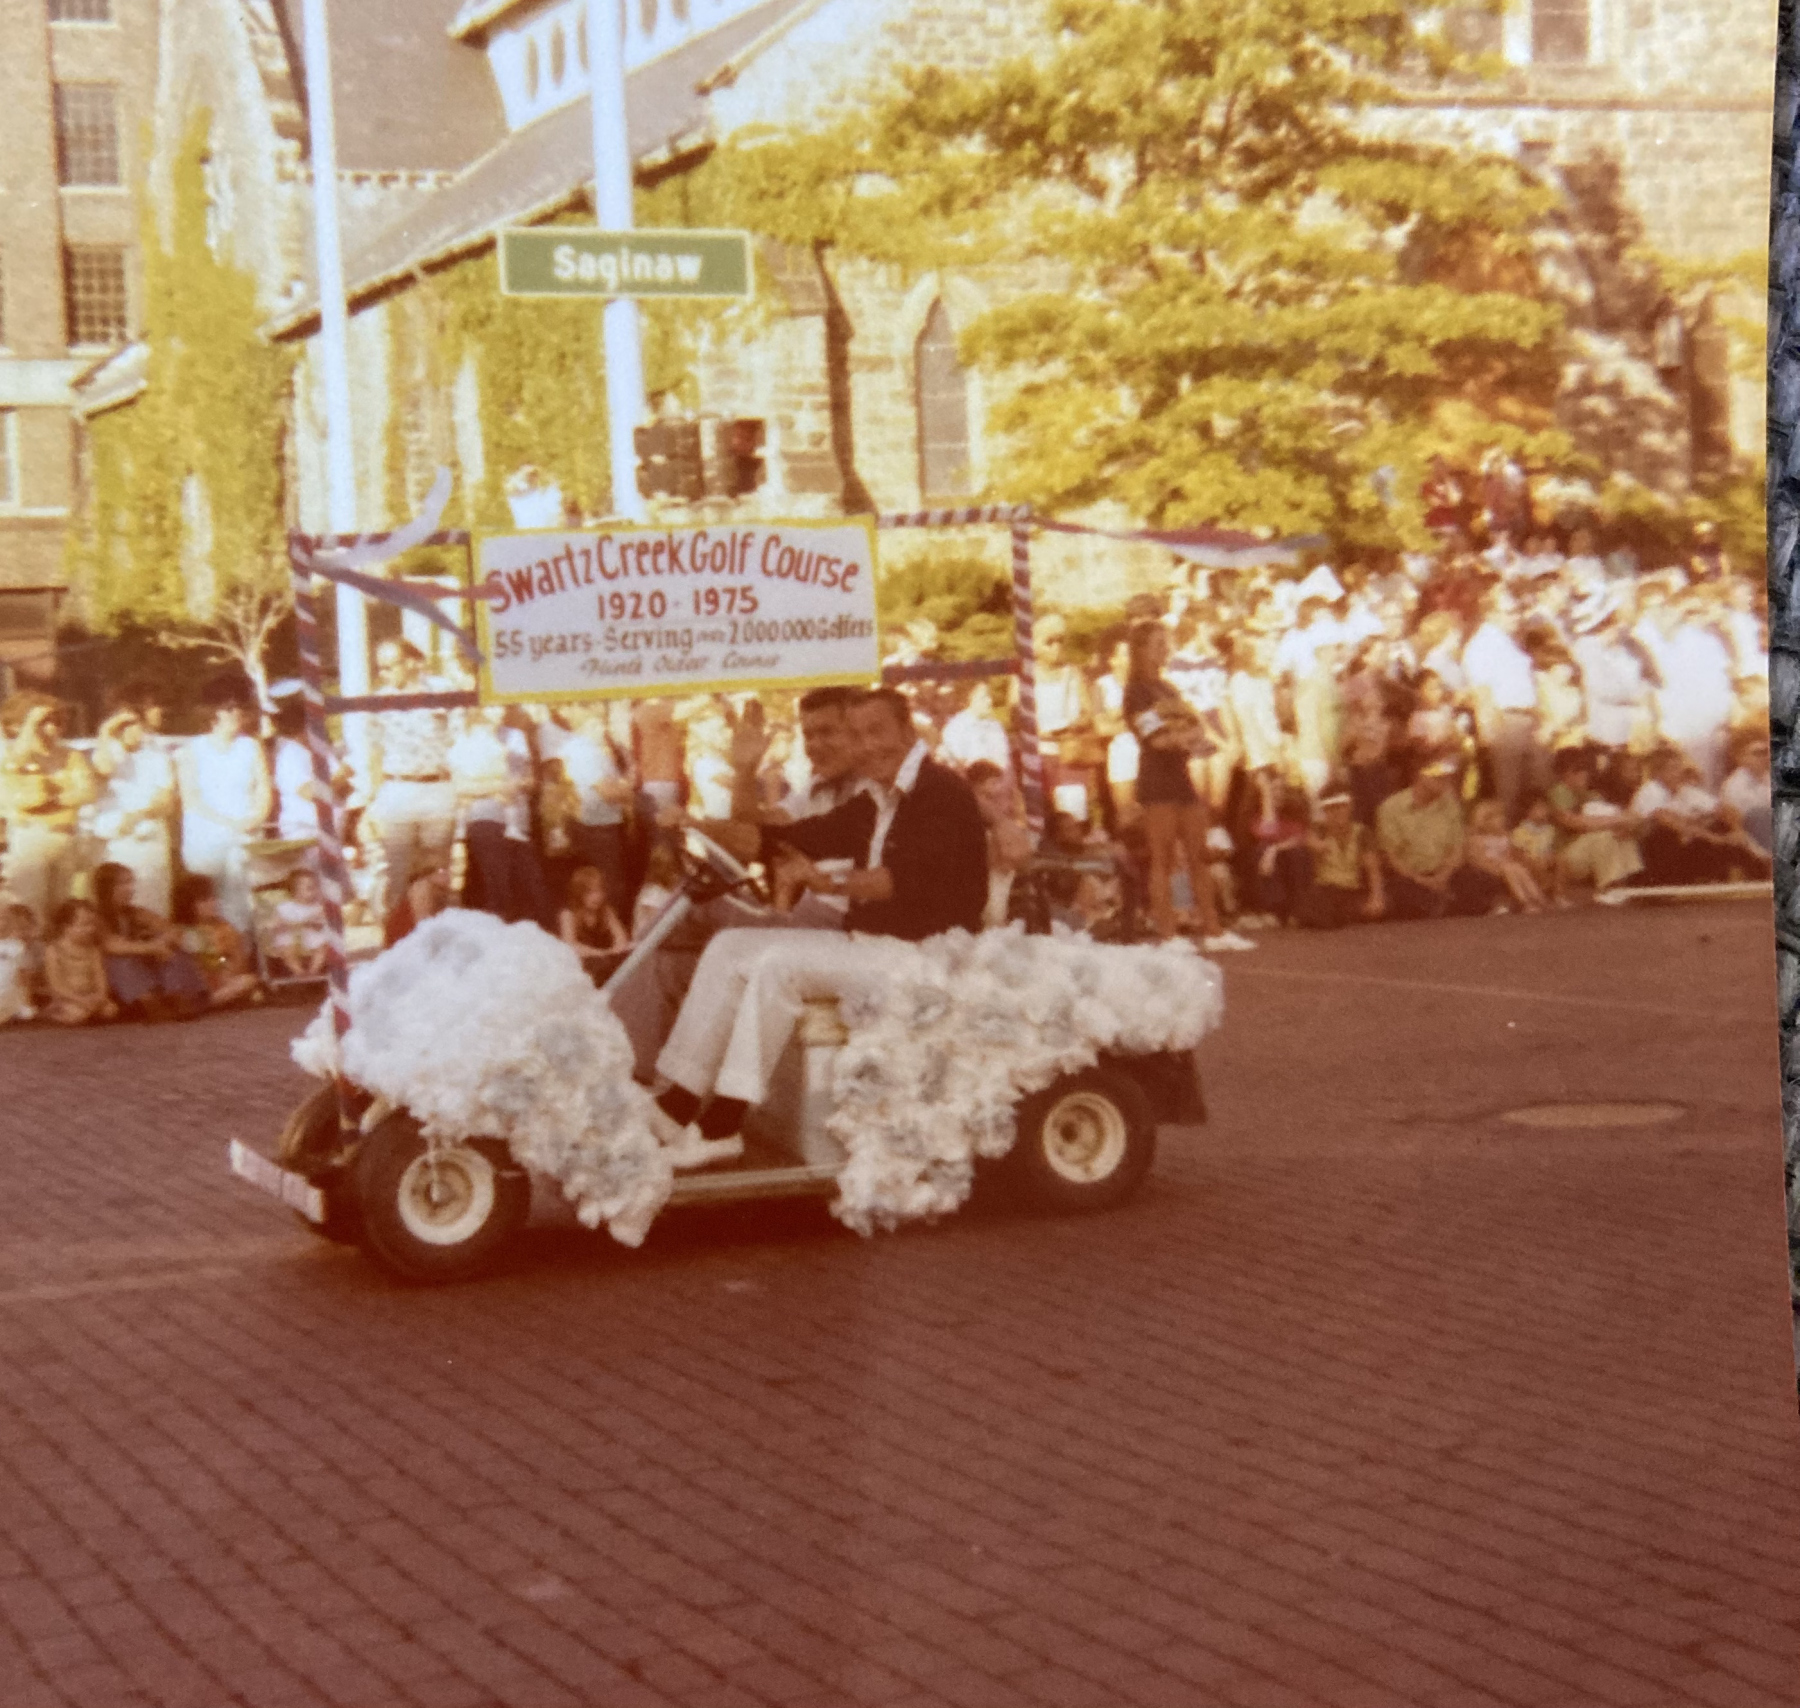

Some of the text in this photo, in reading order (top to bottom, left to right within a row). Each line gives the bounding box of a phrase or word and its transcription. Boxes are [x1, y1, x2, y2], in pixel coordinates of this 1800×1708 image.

[553, 244, 702, 290] Saginaw
[485, 530, 860, 614] Swartz Creek Golf Course
[597, 589, 667, 620] 1920
[693, 585, 759, 616] 1975
[495, 628, 523, 660] 55
[603, 627, 694, 655] Serving
